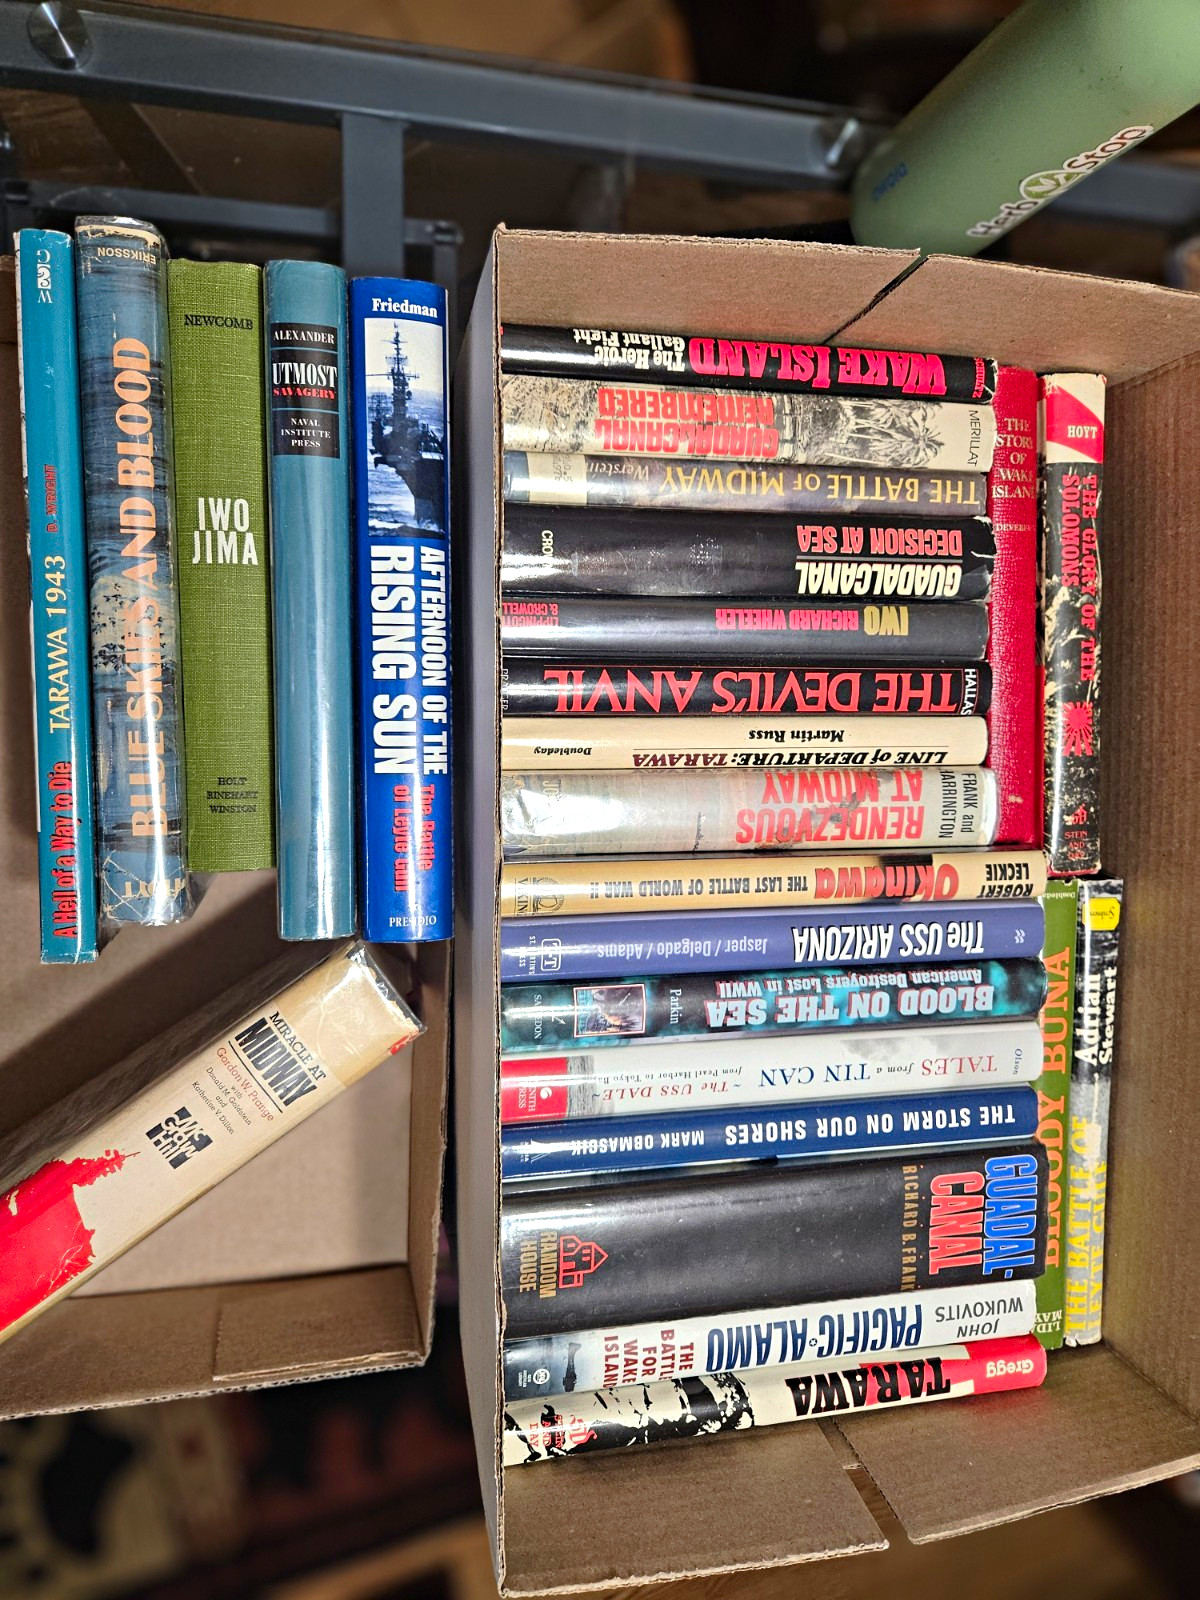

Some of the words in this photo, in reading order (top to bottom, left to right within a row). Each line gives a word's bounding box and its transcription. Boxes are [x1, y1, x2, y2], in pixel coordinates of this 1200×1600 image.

[970, 200, 1041, 237] Herb
[1066, 126, 1153, 172] Stop
[97, 247, 157, 265] ERIKSSON
[184, 314, 254, 330] NEWCOMB
[371, 298, 438, 318] Friedman
[273, 329, 335, 345] ALEXANDER
[573, 328, 619, 347] Fight
[622, 330, 686, 352] Gallant
[594, 345, 649, 370] Heroic
[653, 350, 686, 372] The
[688, 337, 831, 389] ISLAND
[837, 347, 948, 396] WAKE
[272, 362, 338, 388] UTMOST
[273, 386, 336, 400] SAVAGERY
[597, 388, 774, 427] REMEMBERED
[113, 337, 155, 488] BLOOD
[290, 418, 321, 427] NAVAL
[1004, 417, 1031, 432] THE
[280, 428, 331, 439] INSTITUTE
[291, 438, 321, 448] PRESS
[594, 418, 779, 459] GUADALCANAL
[966, 409, 981, 467] MERILLAT
[1067, 424, 1098, 439] HOYT
[1010, 451, 1027, 465] OF
[45, 464, 57, 515] WRIGHT
[659, 466, 786, 497] MIDWAY
[827, 475, 920, 502] BATTLE
[930, 479, 980, 505] THE
[1082, 474, 1097, 520] THE
[198, 497, 250, 532] IWO
[119, 496, 159, 592] AND
[796, 525, 838, 553] SEA
[841, 526, 864, 553] AT
[871, 527, 963, 556] DECISION
[1061, 474, 1081, 588] SOLOMONS
[192, 531, 259, 566] JIMA
[1081, 527, 1096, 597] GLORY
[45, 555, 67, 618] 1943
[795, 562, 962, 597] GUADALCANAL
[370, 545, 417, 680] RISING
[420, 545, 447, 687] AFTERNOON
[502, 602, 550, 616] CROWELL
[715, 608, 787, 631] WHEELER
[789, 609, 859, 631] RICHARD
[864, 605, 909, 636] IWO
[1081, 603, 1096, 630] OF
[1080, 638, 1096, 682] THE
[46, 627, 70, 734] TARAWA
[543, 668, 704, 714] ANVIL
[712, 670, 863, 713] DEVIL'S
[873, 672, 957, 713] THE
[960, 668, 976, 715] HALLAS
[422, 694, 447, 724] OF
[372, 693, 418, 774] SUN
[748, 729, 785, 743] Russ
[790, 729, 845, 743] Martin
[423, 730, 448, 775] THE
[534, 747, 592, 756] Doubleday
[632, 753, 728, 767] TARAWA
[731, 751, 867, 767] DEPARTURE:
[894, 751, 949, 764] LINE
[48, 760, 72, 790] Die
[127, 730, 168, 837] BLUE
[217, 776, 247, 786] HOLT
[761, 770, 880, 804] MIDWAY
[890, 771, 924, 804] AT
[51, 792, 72, 811] to
[420, 784, 435, 815] The
[961, 772, 978, 809] FRANK
[209, 804, 257, 814] WINSTON
[960, 814, 975, 833] and
[50, 816, 82, 852] Way
[392, 808, 412, 854] Leyte
[735, 805, 926, 844] RENDEZVOUS
[1064, 830, 1088, 840] STEIN
[418, 820, 435, 871] Battle
[709, 877, 750, 895] BATTLE
[755, 876, 783, 893] LAST
[787, 876, 808, 892] THE
[815, 863, 960, 903] Okinawa
[985, 862, 1030, 882] LECKIE
[604, 880, 633, 899] WAR
[639, 879, 683, 897] WORLD
[688, 878, 704, 896] OF
[977, 884, 1034, 899] ROBERT
[51, 890, 78, 926] Hell
[597, 942, 644, 960] Adams
[657, 938, 711, 960] Delgado
[724, 935, 769, 954] Jasper
[791, 924, 895, 964] ARIZONA
[899, 923, 943, 957] USS
[948, 921, 984, 954] The
[785, 976, 822, 993] Lost
[826, 971, 908, 992] Destroyers
[910, 968, 983, 985] American
[669, 988, 682, 1025] Parkin
[704, 997, 767, 1028] SEA
[774, 993, 840, 1024] THE
[850, 989, 890, 1019] ON
[896, 985, 995, 1016] BLOOD
[1041, 946, 1070, 1075] BUNA
[1074, 973, 1101, 1067] Adrian
[1099, 966, 1118, 1066] Stewart
[269, 1010, 315, 1066] MIRACLE
[308, 1059, 327, 1081] AT
[234, 1016, 318, 1107] MIDWAY
[658, 1071, 692, 1080] Harbor
[695, 1069, 719, 1078] Pearl
[722, 1065, 743, 1076] from
[823, 1063, 871, 1083] TIN
[887, 1062, 915, 1076] from
[922, 1055, 998, 1076] TALES
[1013, 1048, 1023, 1076] Olson
[216, 1046, 244, 1085] Gordon
[250, 1089, 274, 1122] Prange
[661, 1084, 692, 1096] USS
[701, 1081, 729, 1092] The
[759, 1065, 815, 1088] CAN
[602, 1086, 652, 1101] DALE
[816, 1116, 857, 1139] OUR
[867, 1113, 894, 1133] ON
[903, 1107, 971, 1131] STORM
[979, 1104, 1016, 1125] THE
[661, 1129, 705, 1149] MARK
[725, 1119, 807, 1146] SHORES
[901, 1165, 920, 1228] RICHARD
[929, 1171, 985, 1276] CANAL
[983, 1154, 1038, 1279] GUADAL-
[1067, 1164, 1092, 1269] BATTLE
[519, 1240, 537, 1293] HOUSE
[539, 1231, 558, 1299] RANDOM
[901, 1247, 917, 1292] FRANK
[1087, 1245, 1104, 1331] LEYTE
[935, 1297, 1024, 1323] WUKOVITS
[1065, 1278, 1089, 1334] THE
[816, 1304, 922, 1358] PACIFIC
[956, 1321, 1000, 1338] JOHN
[678, 1342, 694, 1371] THE
[705, 1318, 808, 1373] ALAMO
[622, 1339, 638, 1384] WAKE
[641, 1346, 657, 1377] FOR
[986, 1359, 1034, 1378] Gregg
[785, 1356, 951, 1417] TARAWA
